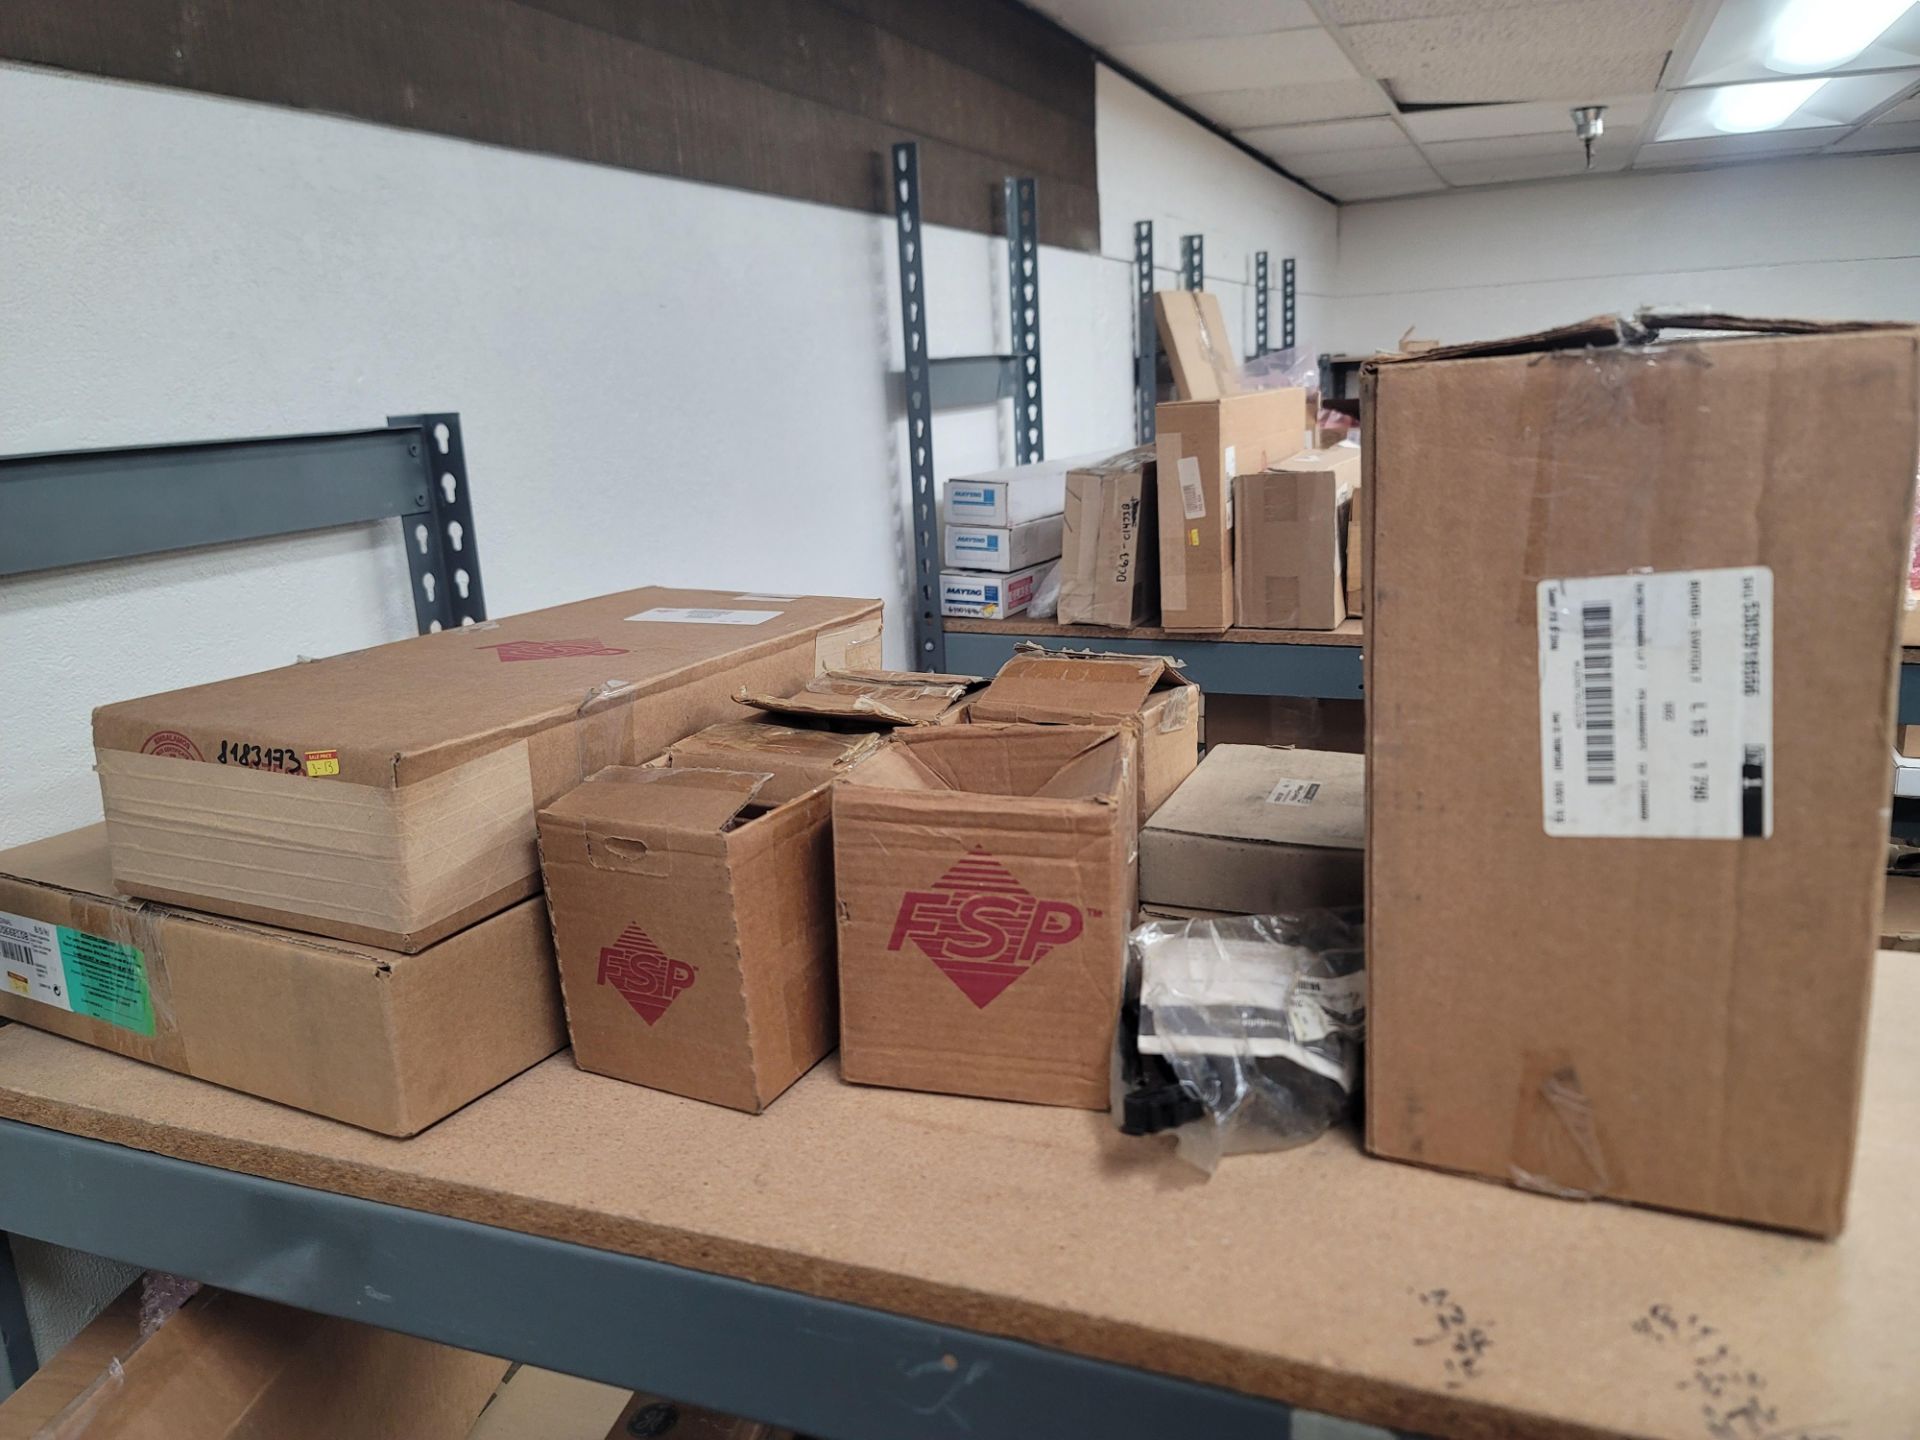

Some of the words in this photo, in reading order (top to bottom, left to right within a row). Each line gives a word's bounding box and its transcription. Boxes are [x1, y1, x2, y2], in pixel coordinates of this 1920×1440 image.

[946, 586, 982, 597] MAYTAG
[217, 740, 301, 773] 8183173
[887, 891, 1084, 963] FSP
[596, 947, 696, 997] FSP
